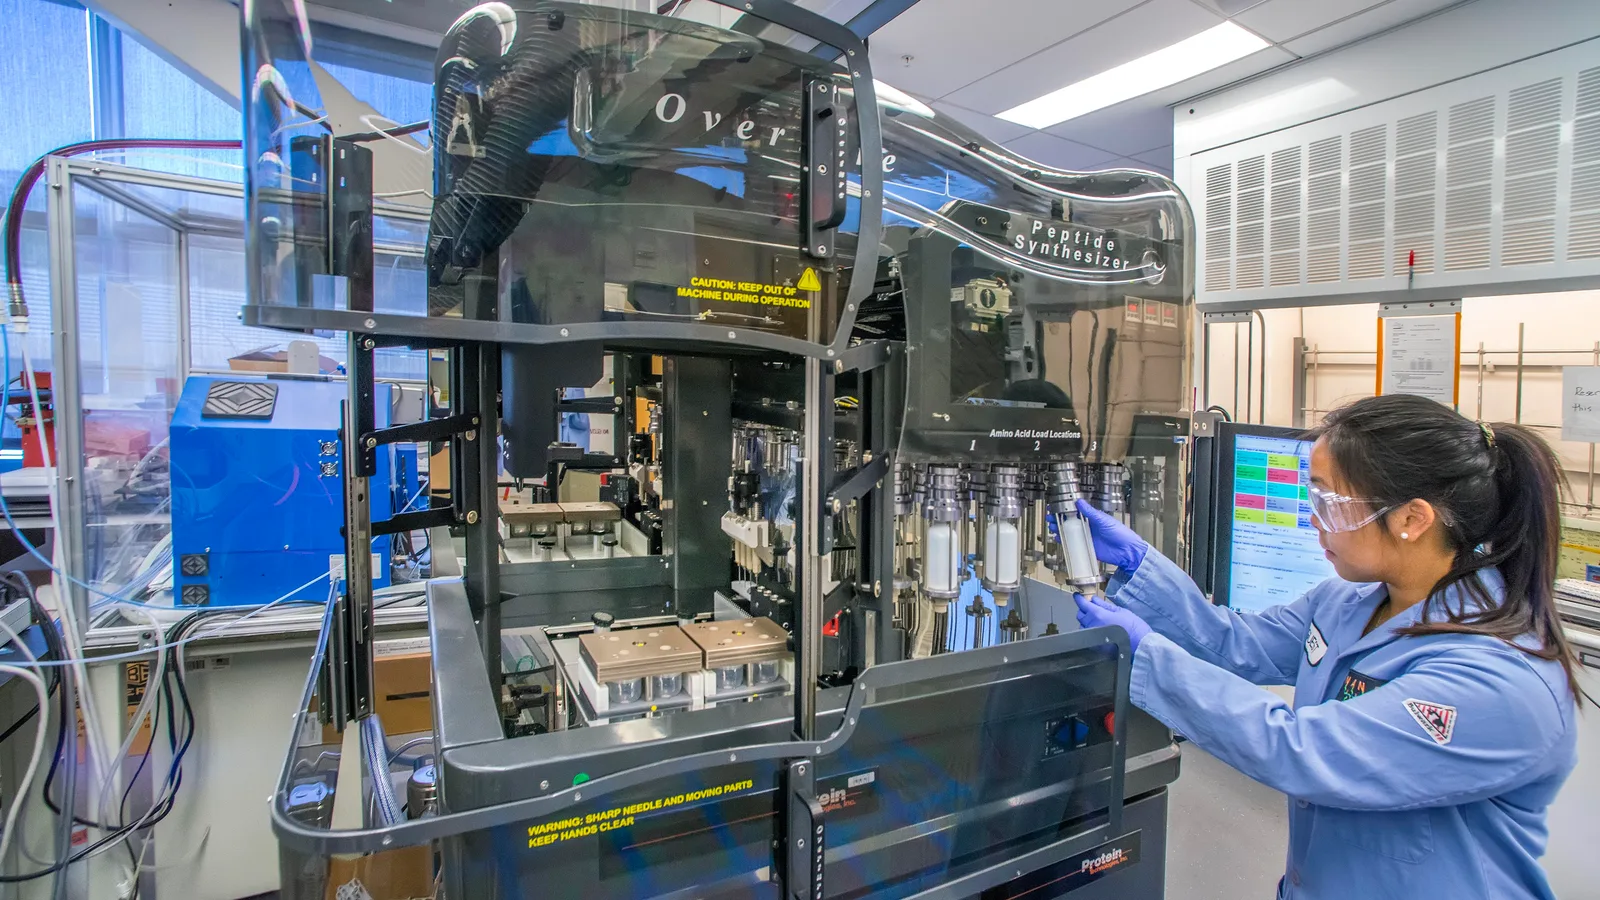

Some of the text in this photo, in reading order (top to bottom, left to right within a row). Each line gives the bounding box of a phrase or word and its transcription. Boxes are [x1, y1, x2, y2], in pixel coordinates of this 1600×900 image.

[1032, 220, 1115, 251] Peptide
[1014, 234, 1129, 270] Synthesizer
[677, 287, 811, 309] MACHINE DURING OPERATION
[690, 277, 797, 296] CAUTION: KEEP OUT OF
[969, 439, 1097, 451] 1 2 3
[989, 429, 1081, 439] Amino Acid Load Locations
[528, 779, 753, 836] WARNING: SHARP NEEDLE AND MOVING PARTS
[528, 816, 635, 848] KEEP HANDS CLEAR
[1081, 848, 1122, 873] Protein
